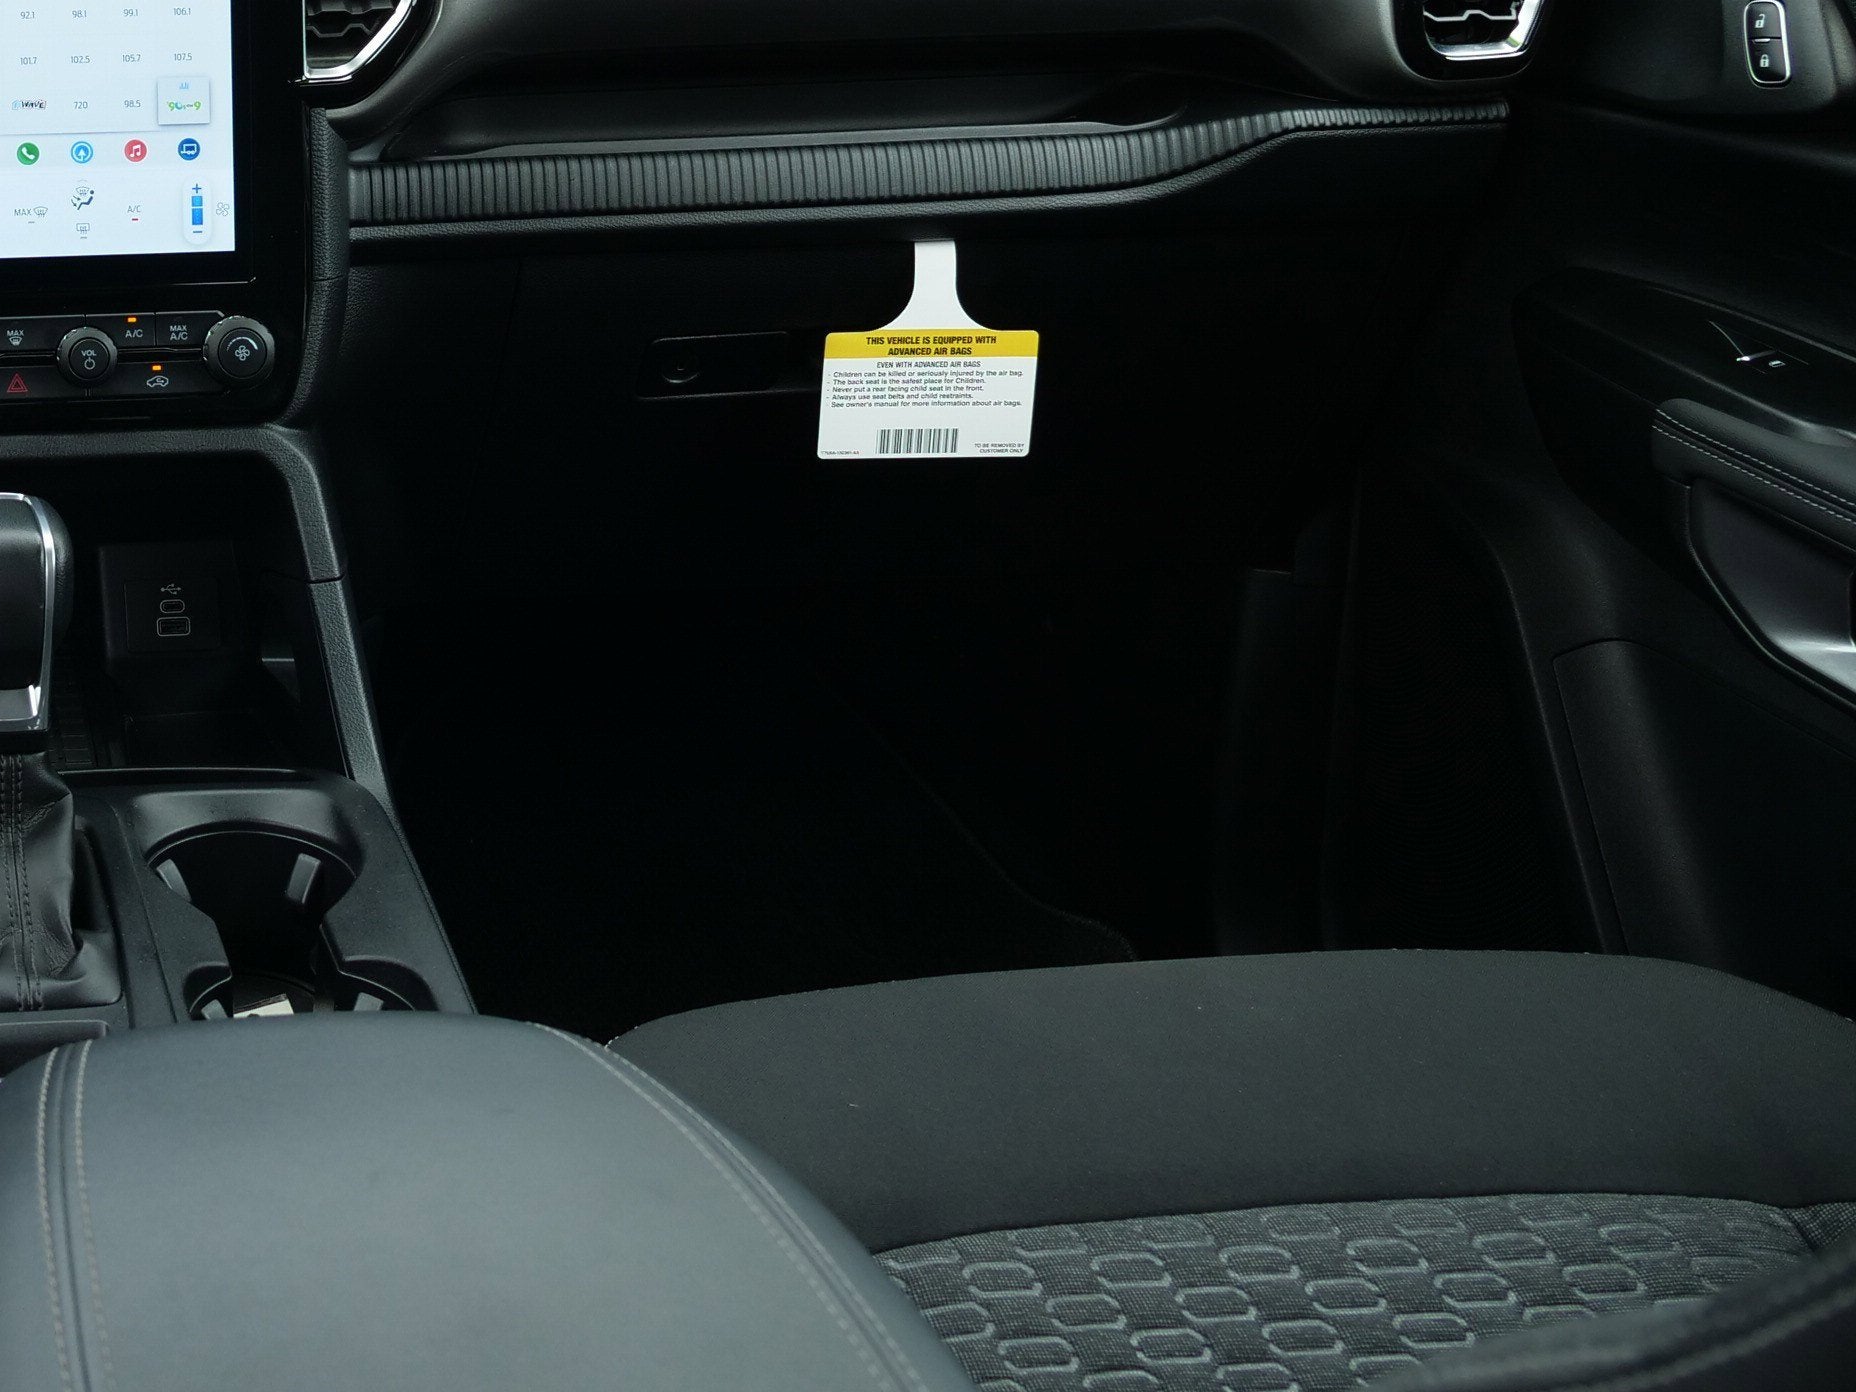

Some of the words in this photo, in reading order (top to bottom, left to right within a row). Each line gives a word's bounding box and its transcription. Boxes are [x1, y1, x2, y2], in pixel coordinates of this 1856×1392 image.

[20, 10, 36, 19] 92.1
[72, 10, 88, 18] 98.1
[123, 8, 139, 17] 99.1
[173, 7, 192, 16] 106.1
[20, 56, 37, 65] 101.7
[70, 55, 91, 64] 102.5
[122, 54, 141, 63] 105.7
[173, 52, 193, 61] 107.5
[73, 101, 88, 109] 720
[124, 99, 141, 108] 98.5
[14, 208, 32, 217] MAX
[127, 205, 141, 213] A/C
[7, 329, 24, 338] MAX
[169, 325, 187, 333] MAX
[125, 329, 143, 339] A/C
[169, 331, 188, 341] A/C
[866, 336, 885, 345] THIS
[887, 336, 920, 345] VEHICLE
[922, 336, 931, 345] IS
[932, 336, 973, 345] EQUIPPED
[975, 336, 997, 344] WITH
[888, 347, 932, 356] ADVANCED
[934, 347, 948, 355] AIR
[950, 347, 972, 355] BAGS
[917, 370, 948, 378] seriously
